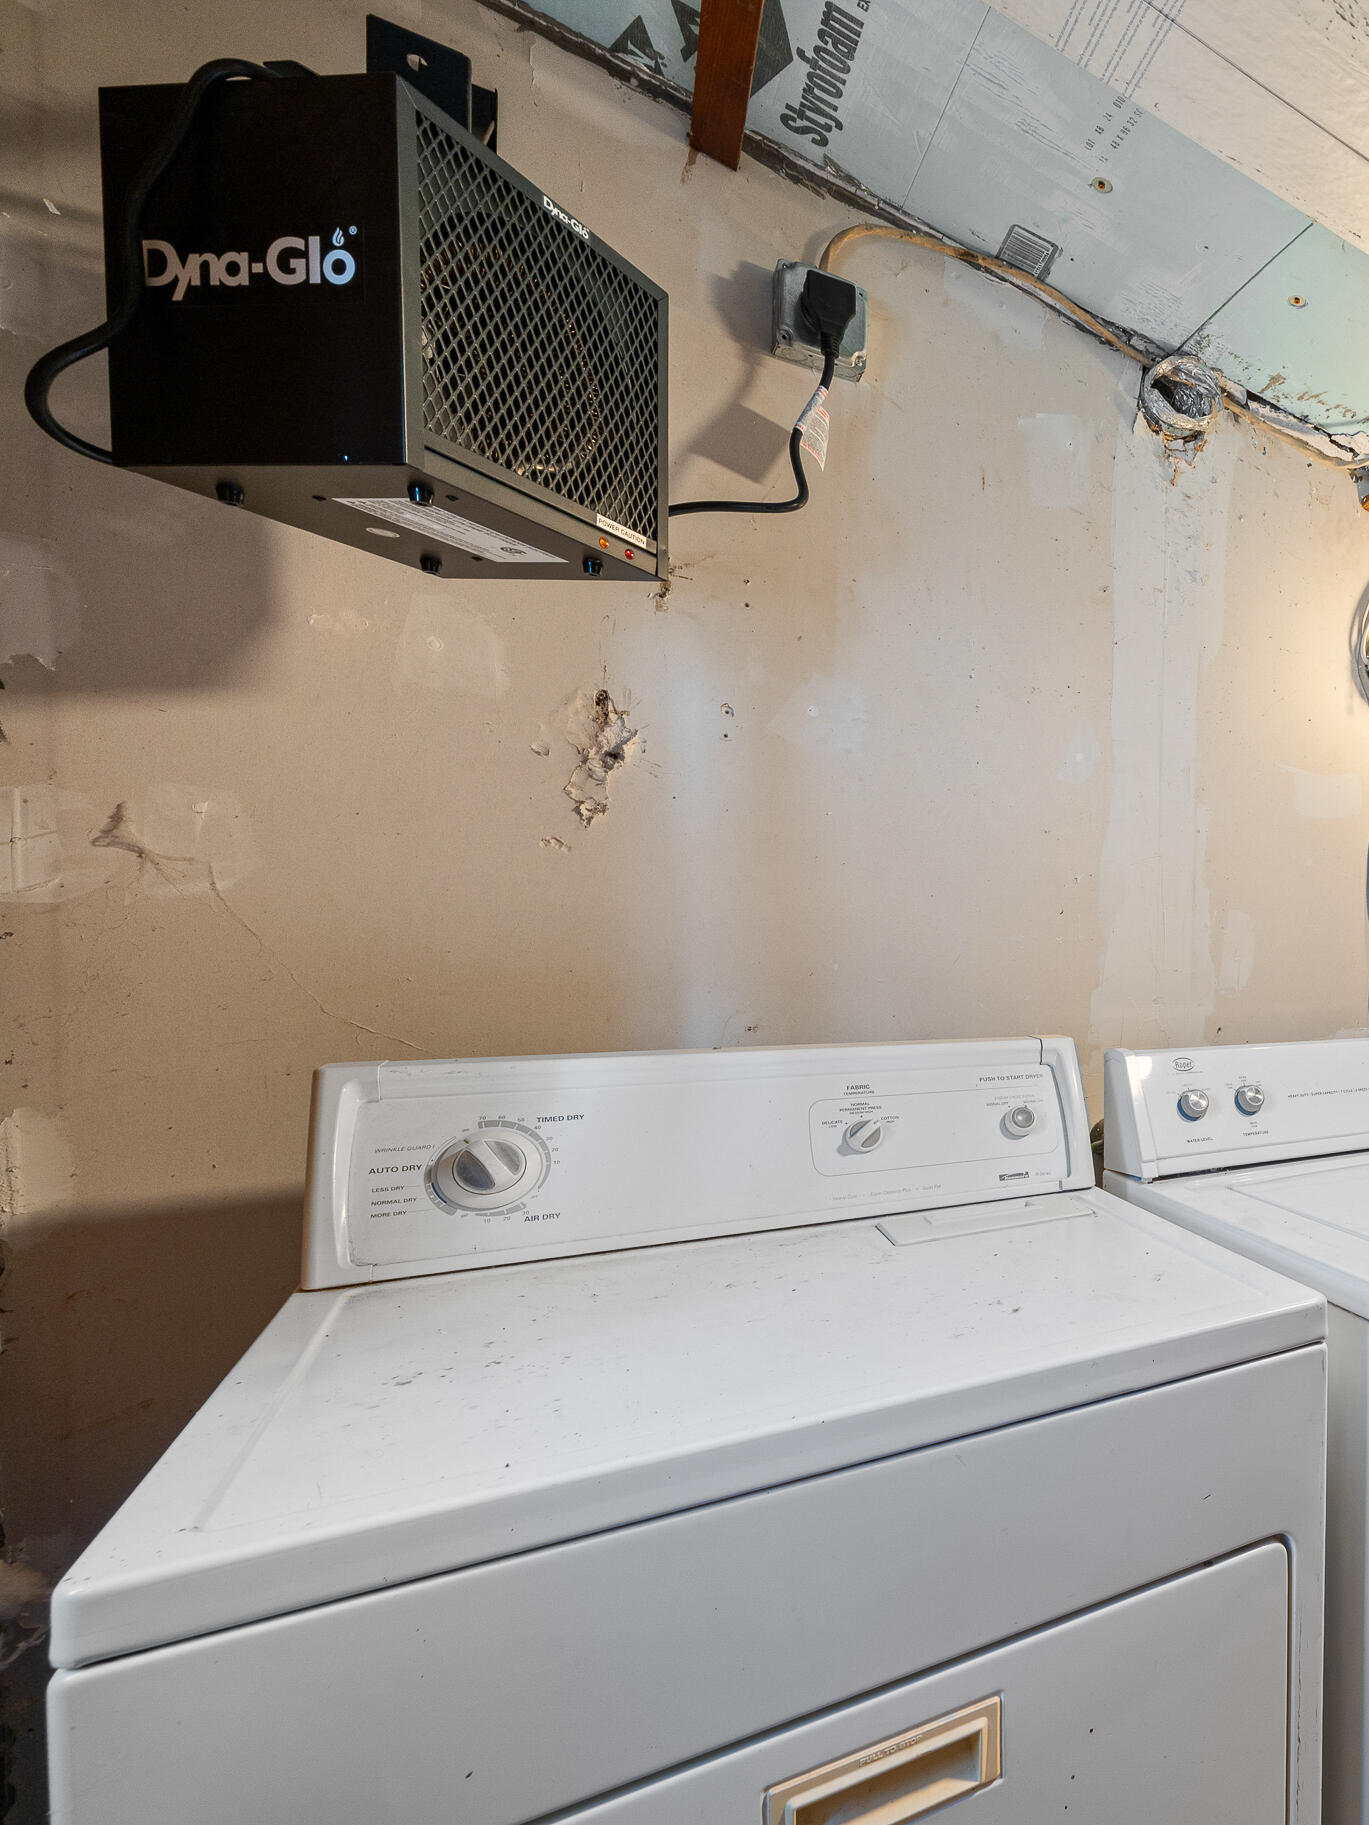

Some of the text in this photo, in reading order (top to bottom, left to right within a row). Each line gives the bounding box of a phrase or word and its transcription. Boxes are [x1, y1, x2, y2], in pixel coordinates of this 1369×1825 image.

[779, 0, 865, 147] Styrofoam
[543, 195, 589, 239] Dyna-Glo
[142, 226, 357, 301] Dyna-Glo
[598, 518, 645, 545] POWER CAUTION
[536, 1114, 585, 1123] TIMED DRY
[375, 1144, 431, 1154] WRINKLE GUARD
[369, 1164, 422, 1175] AUTO DRY
[371, 1198, 401, 1206] NORMAL
[370, 1211, 391, 1219] MORE
[524, 1213, 561, 1223] AIR DRY
